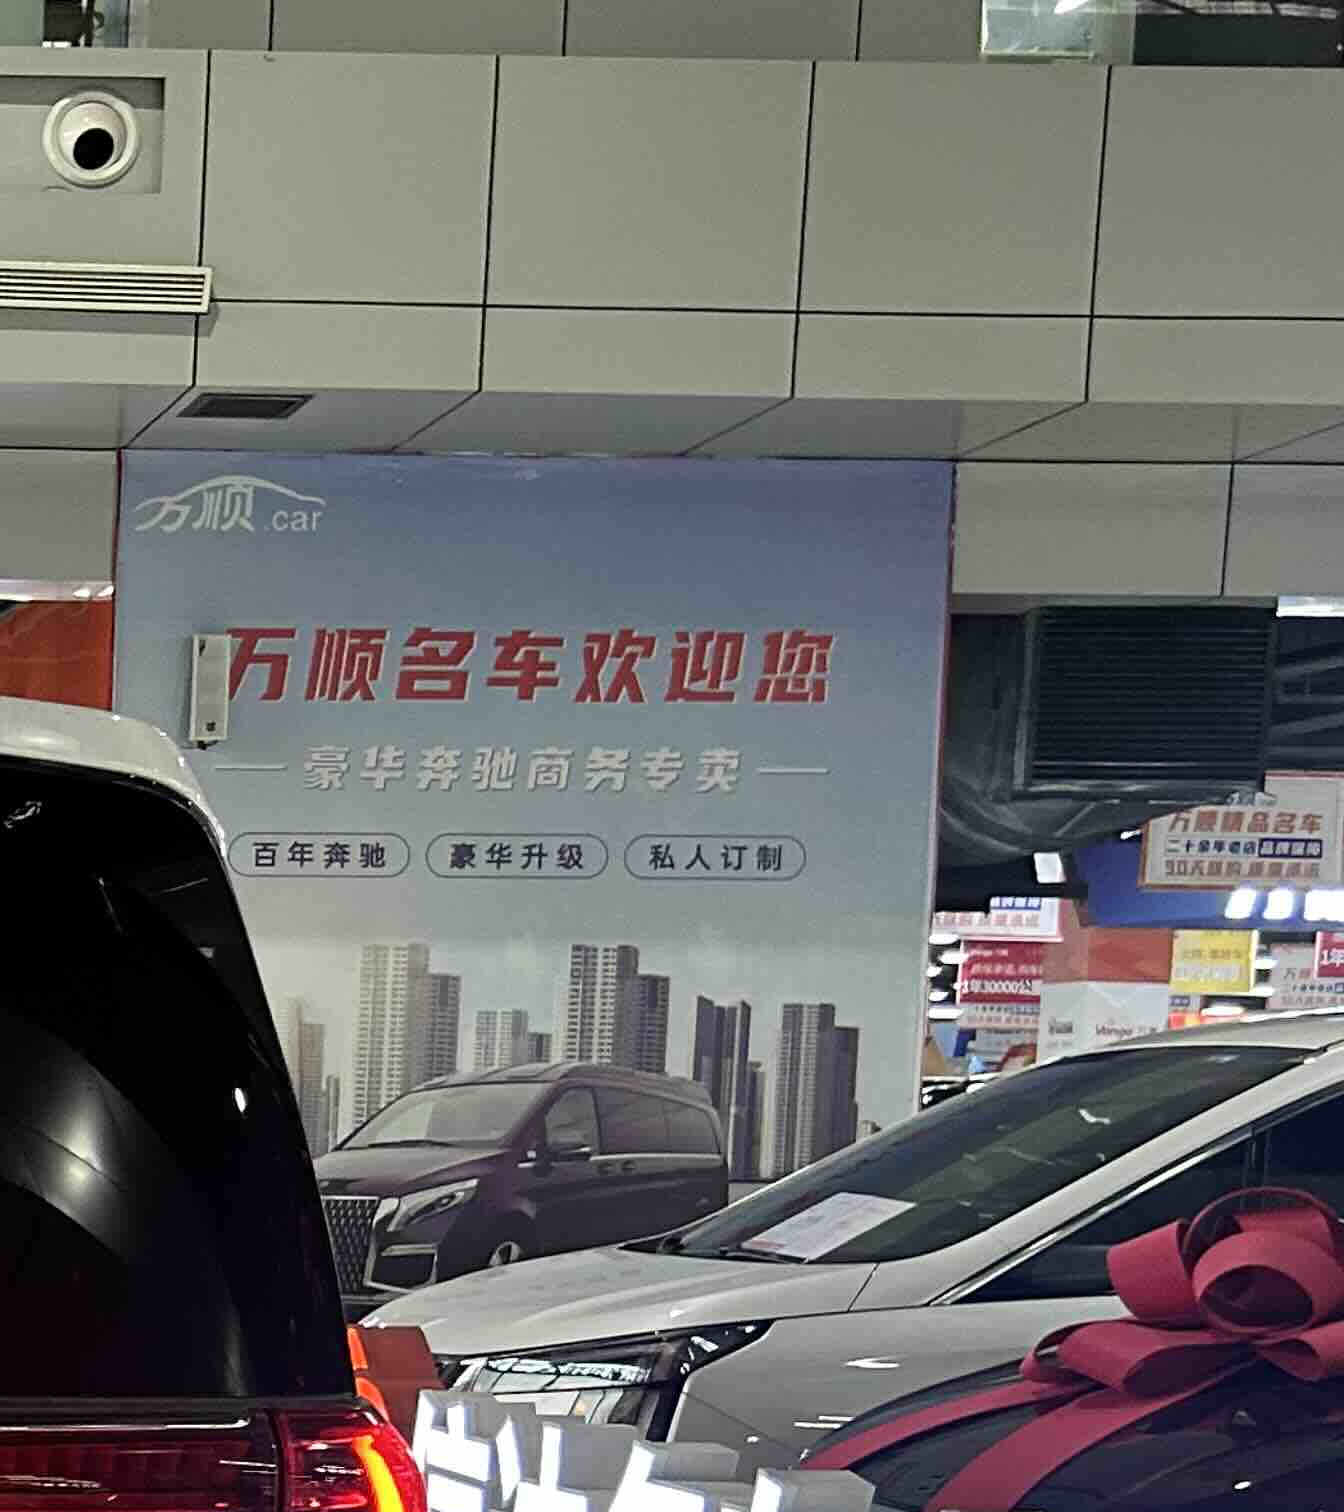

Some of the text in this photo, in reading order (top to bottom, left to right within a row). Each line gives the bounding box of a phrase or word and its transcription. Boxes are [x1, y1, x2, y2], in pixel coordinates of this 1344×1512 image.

[135, 483, 255, 533] 万顺
[225, 626, 837, 705] 万顺名车欢迎您
[304, 745, 744, 793] 豪华奔驰商务专卖
[252, 842, 387, 869] 百年奔驰
[449, 843, 585, 871] 豪华升级
[649, 844, 783, 871] 私人订制
